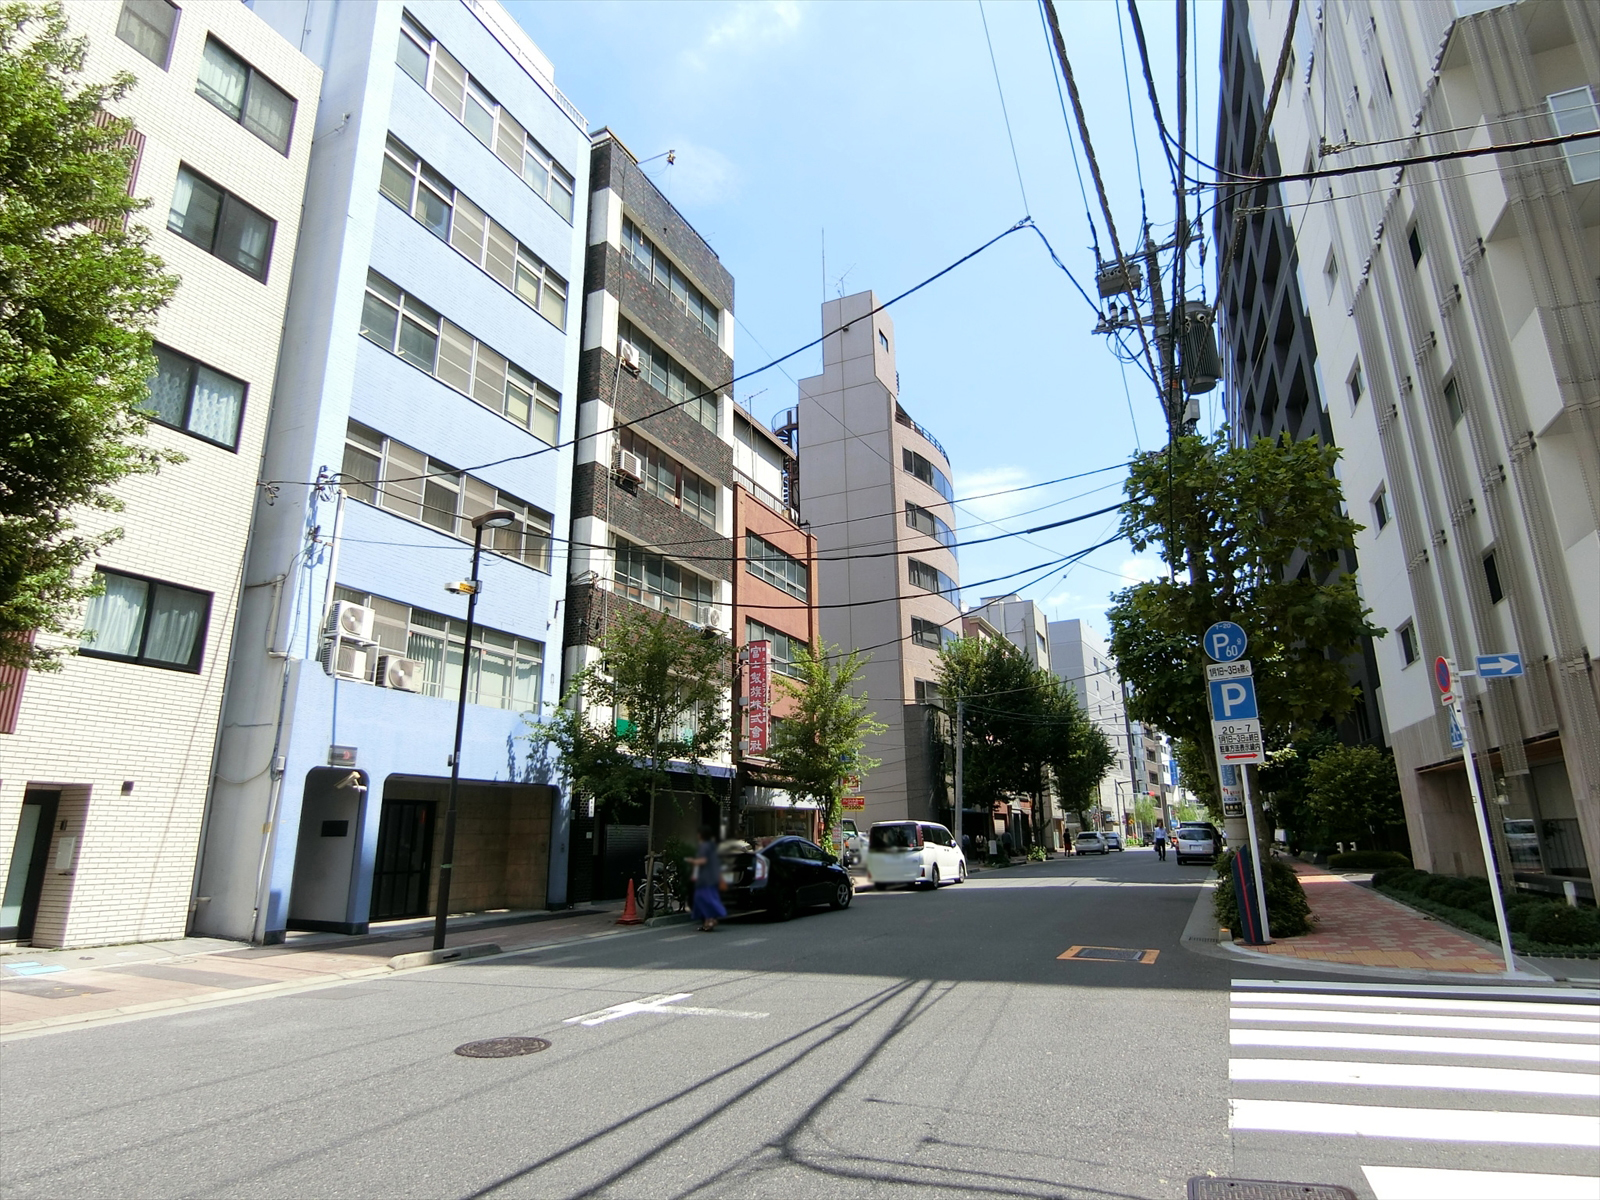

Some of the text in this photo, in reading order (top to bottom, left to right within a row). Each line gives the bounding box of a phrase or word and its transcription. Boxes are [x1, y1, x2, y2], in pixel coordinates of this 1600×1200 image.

[1212, 633, 1239, 659] P 60
[1220, 682, 1247, 717] P
